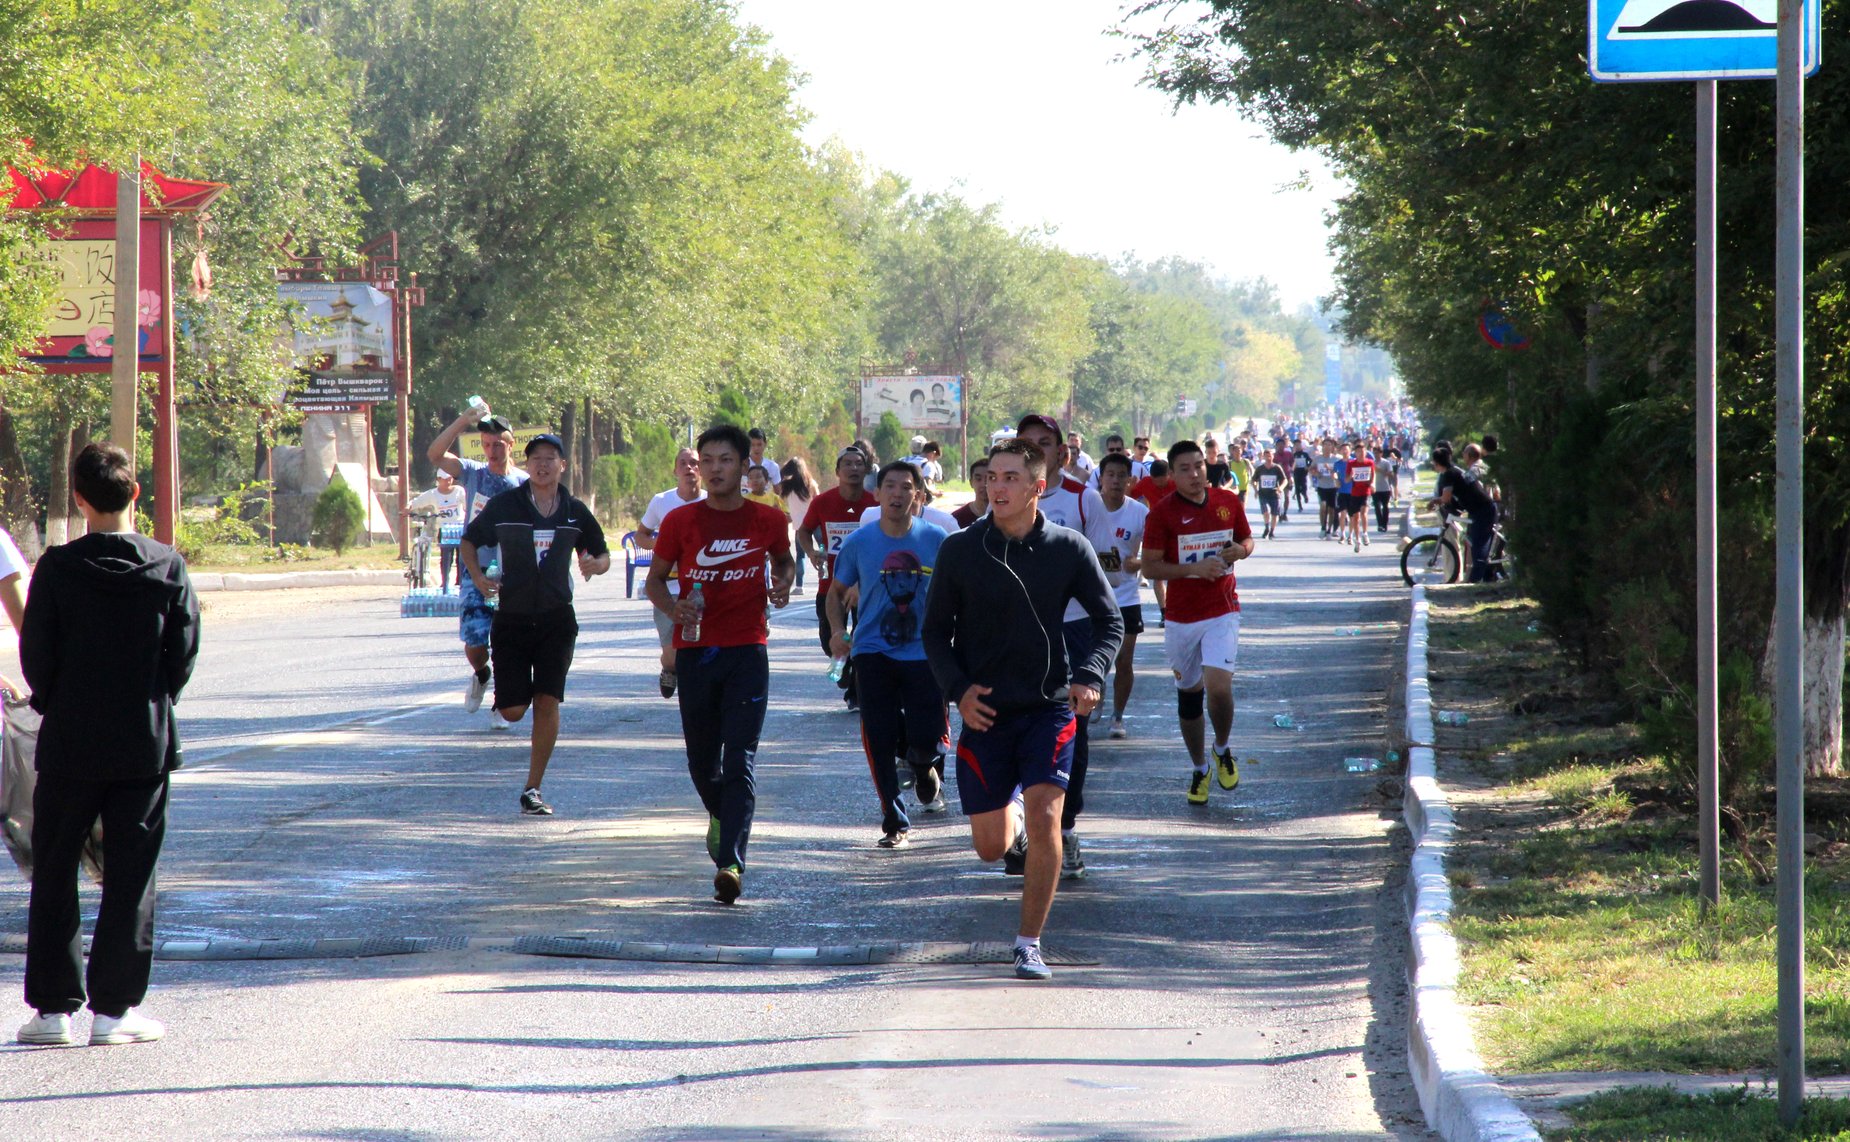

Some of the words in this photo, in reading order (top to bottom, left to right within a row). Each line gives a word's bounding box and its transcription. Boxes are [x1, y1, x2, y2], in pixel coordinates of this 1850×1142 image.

[709, 538, 750, 552] NIKE
[685, 568, 719, 581] JUST
[722, 569, 745, 582] DO
[745, 565, 759, 578] IT
